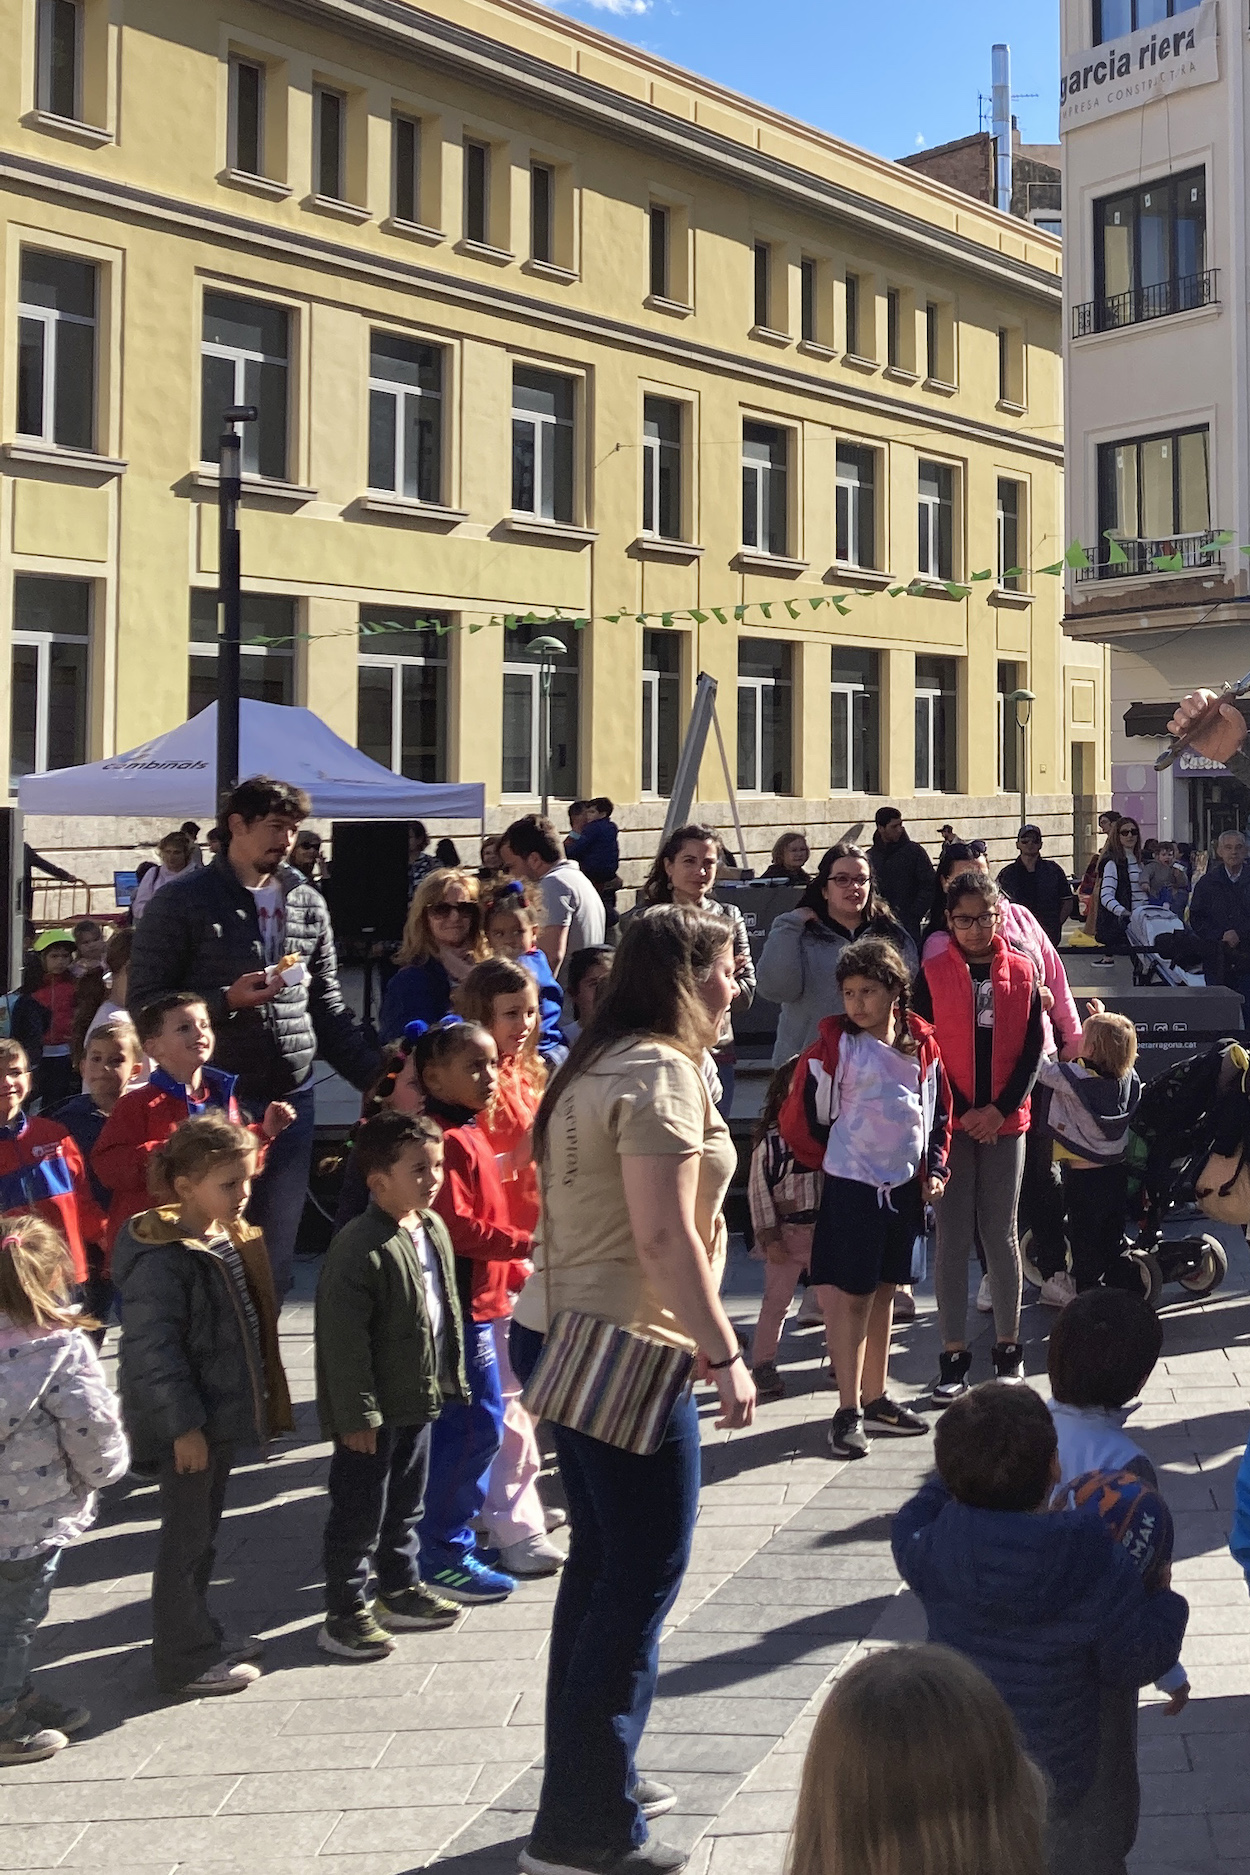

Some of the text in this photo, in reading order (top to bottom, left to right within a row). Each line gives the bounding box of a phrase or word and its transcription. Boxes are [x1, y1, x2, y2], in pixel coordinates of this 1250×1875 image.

[1060, 27, 1196, 107] garcia riera
[1062, 97, 1100, 120] MPRESA
